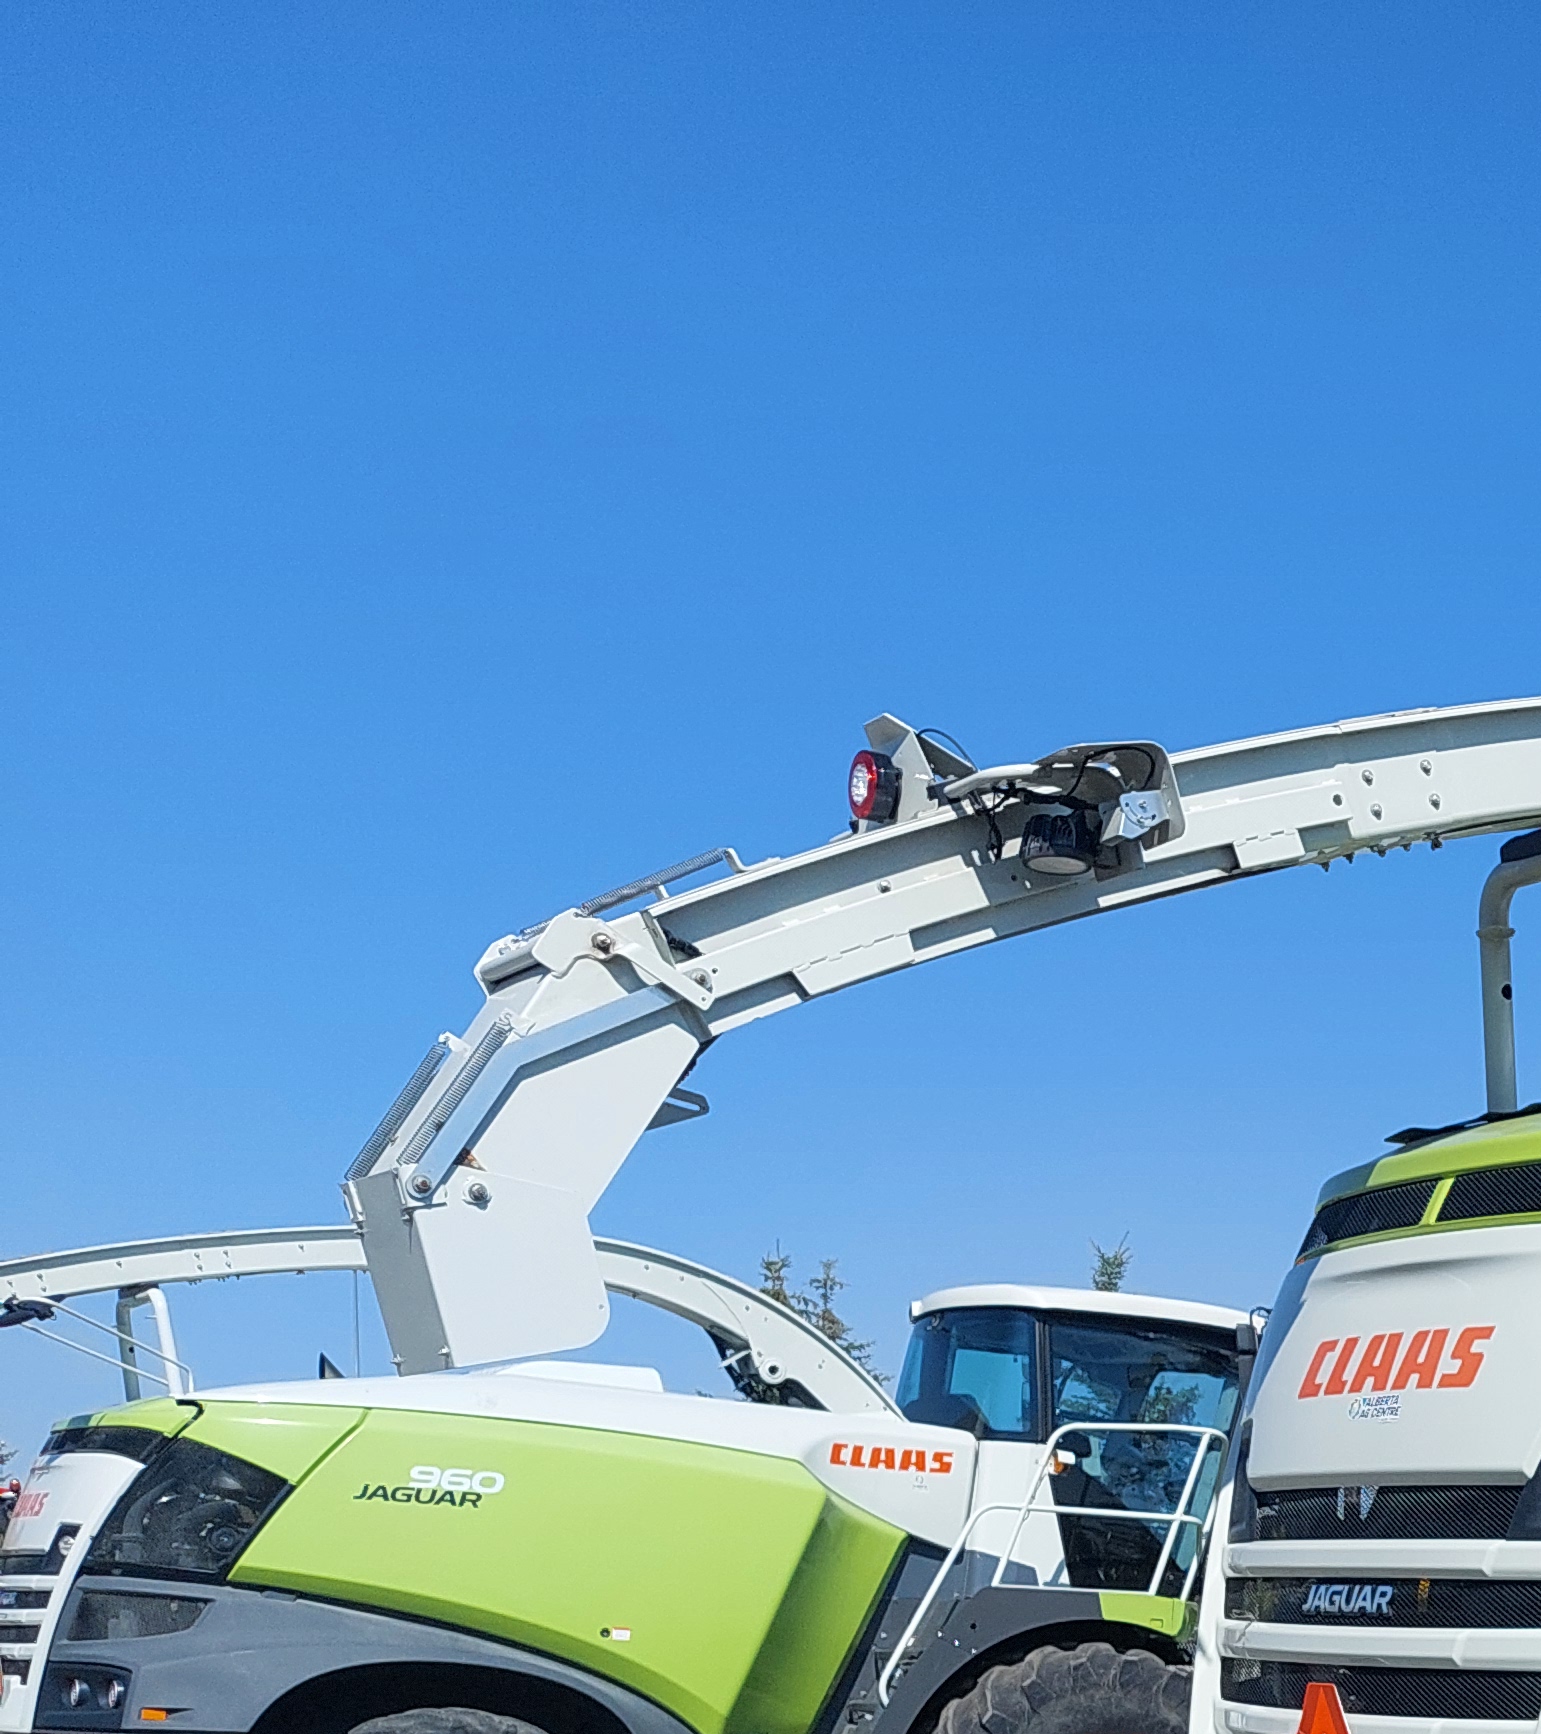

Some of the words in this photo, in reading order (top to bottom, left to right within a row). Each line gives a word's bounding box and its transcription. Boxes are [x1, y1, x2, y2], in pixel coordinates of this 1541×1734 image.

[1298, 1326, 1495, 1400] CLAAS
[829, 1443, 954, 1473] CLAAS
[408, 1465, 505, 1494] 960
[353, 1484, 482, 1508] JAGUAR
[1302, 1584, 1393, 1614] JAGUAR
